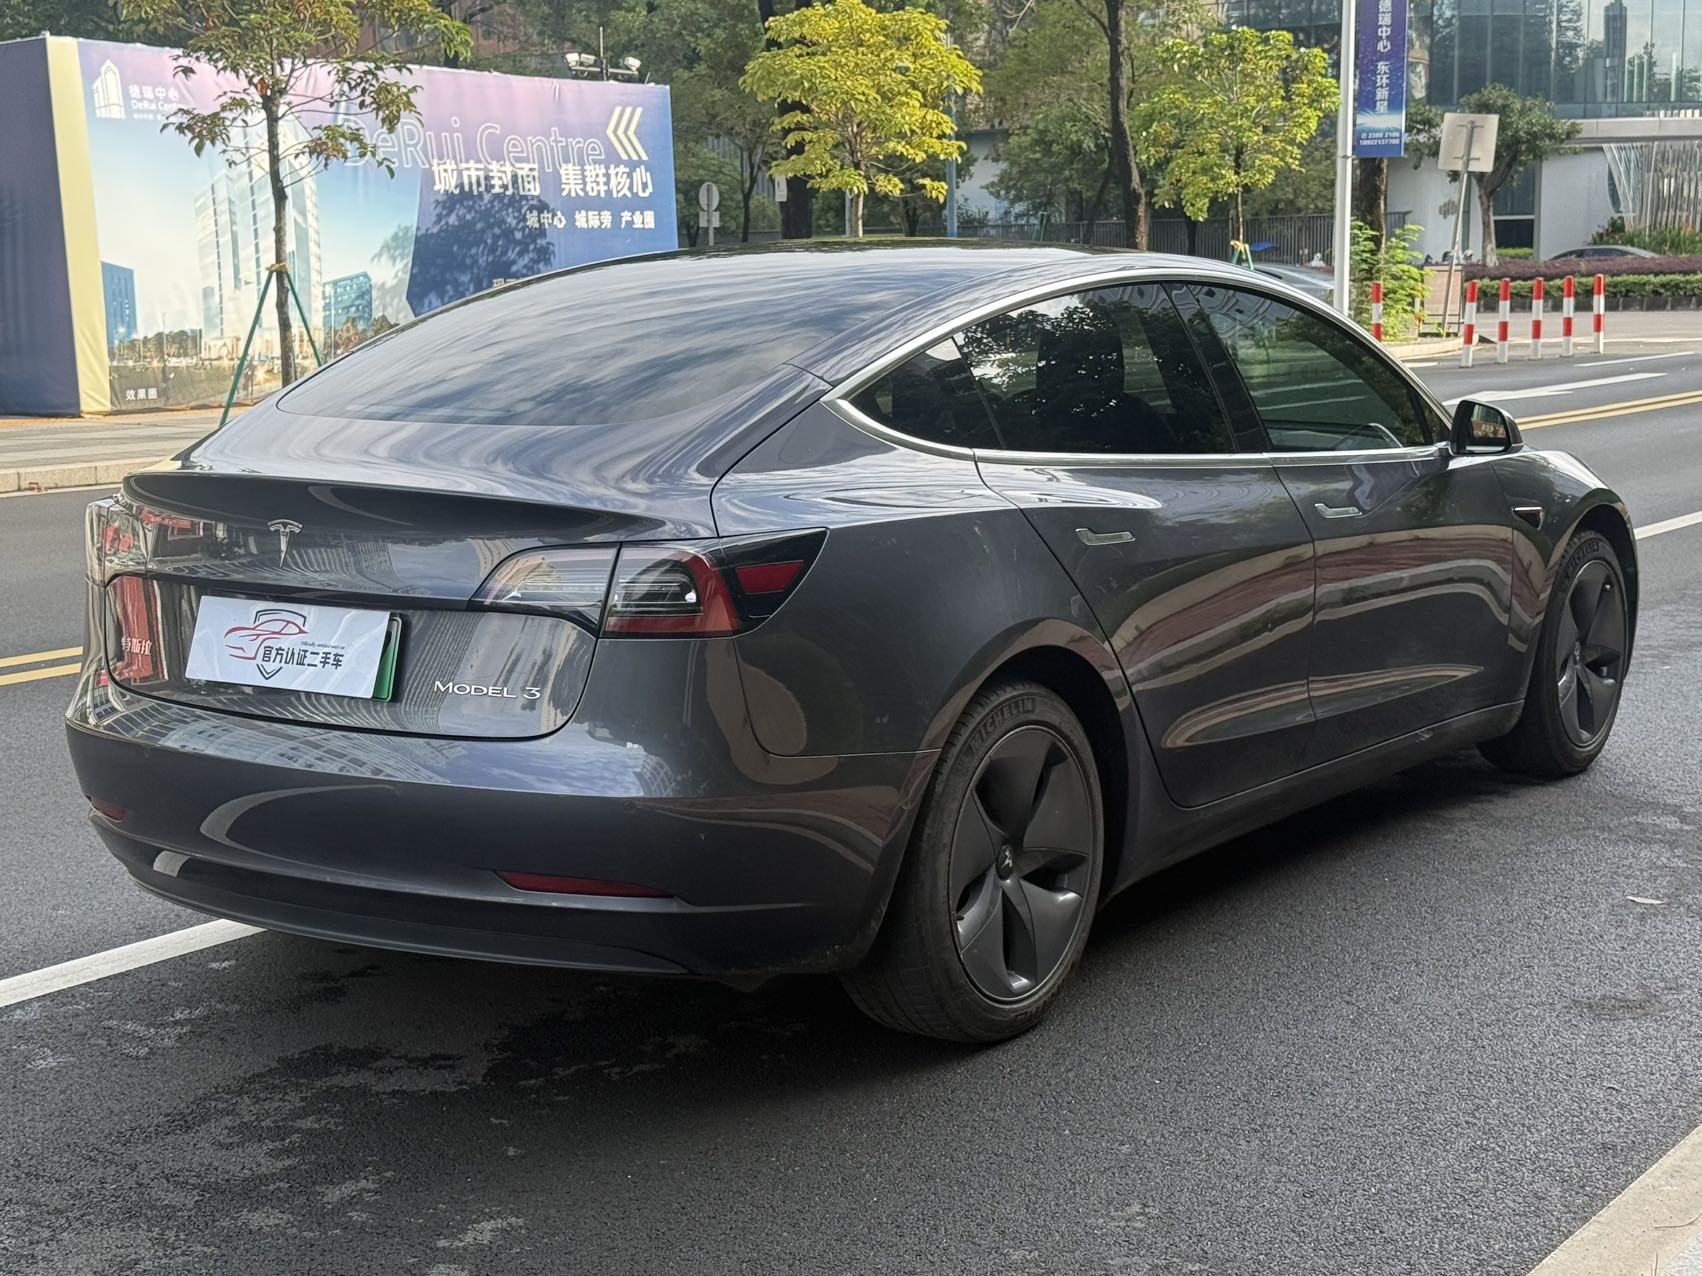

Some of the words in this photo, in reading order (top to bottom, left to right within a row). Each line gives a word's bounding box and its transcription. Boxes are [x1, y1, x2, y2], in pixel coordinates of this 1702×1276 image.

[1374, 61, 1391, 114] 东环新星
[476, 122, 606, 172] Centre
[431, 158, 540, 196] 城市封面
[560, 163, 654, 199] 集群核心
[525, 210, 567, 229] 城中心
[574, 209, 613, 230] 城际旁
[121, 636, 153, 656] 特斯拉
[262, 645, 344, 669] 官方认证二手车
[434, 681, 517, 698] MODEL
[523, 686, 541, 700] 3
[967, 697, 1035, 753] MICHELIN
